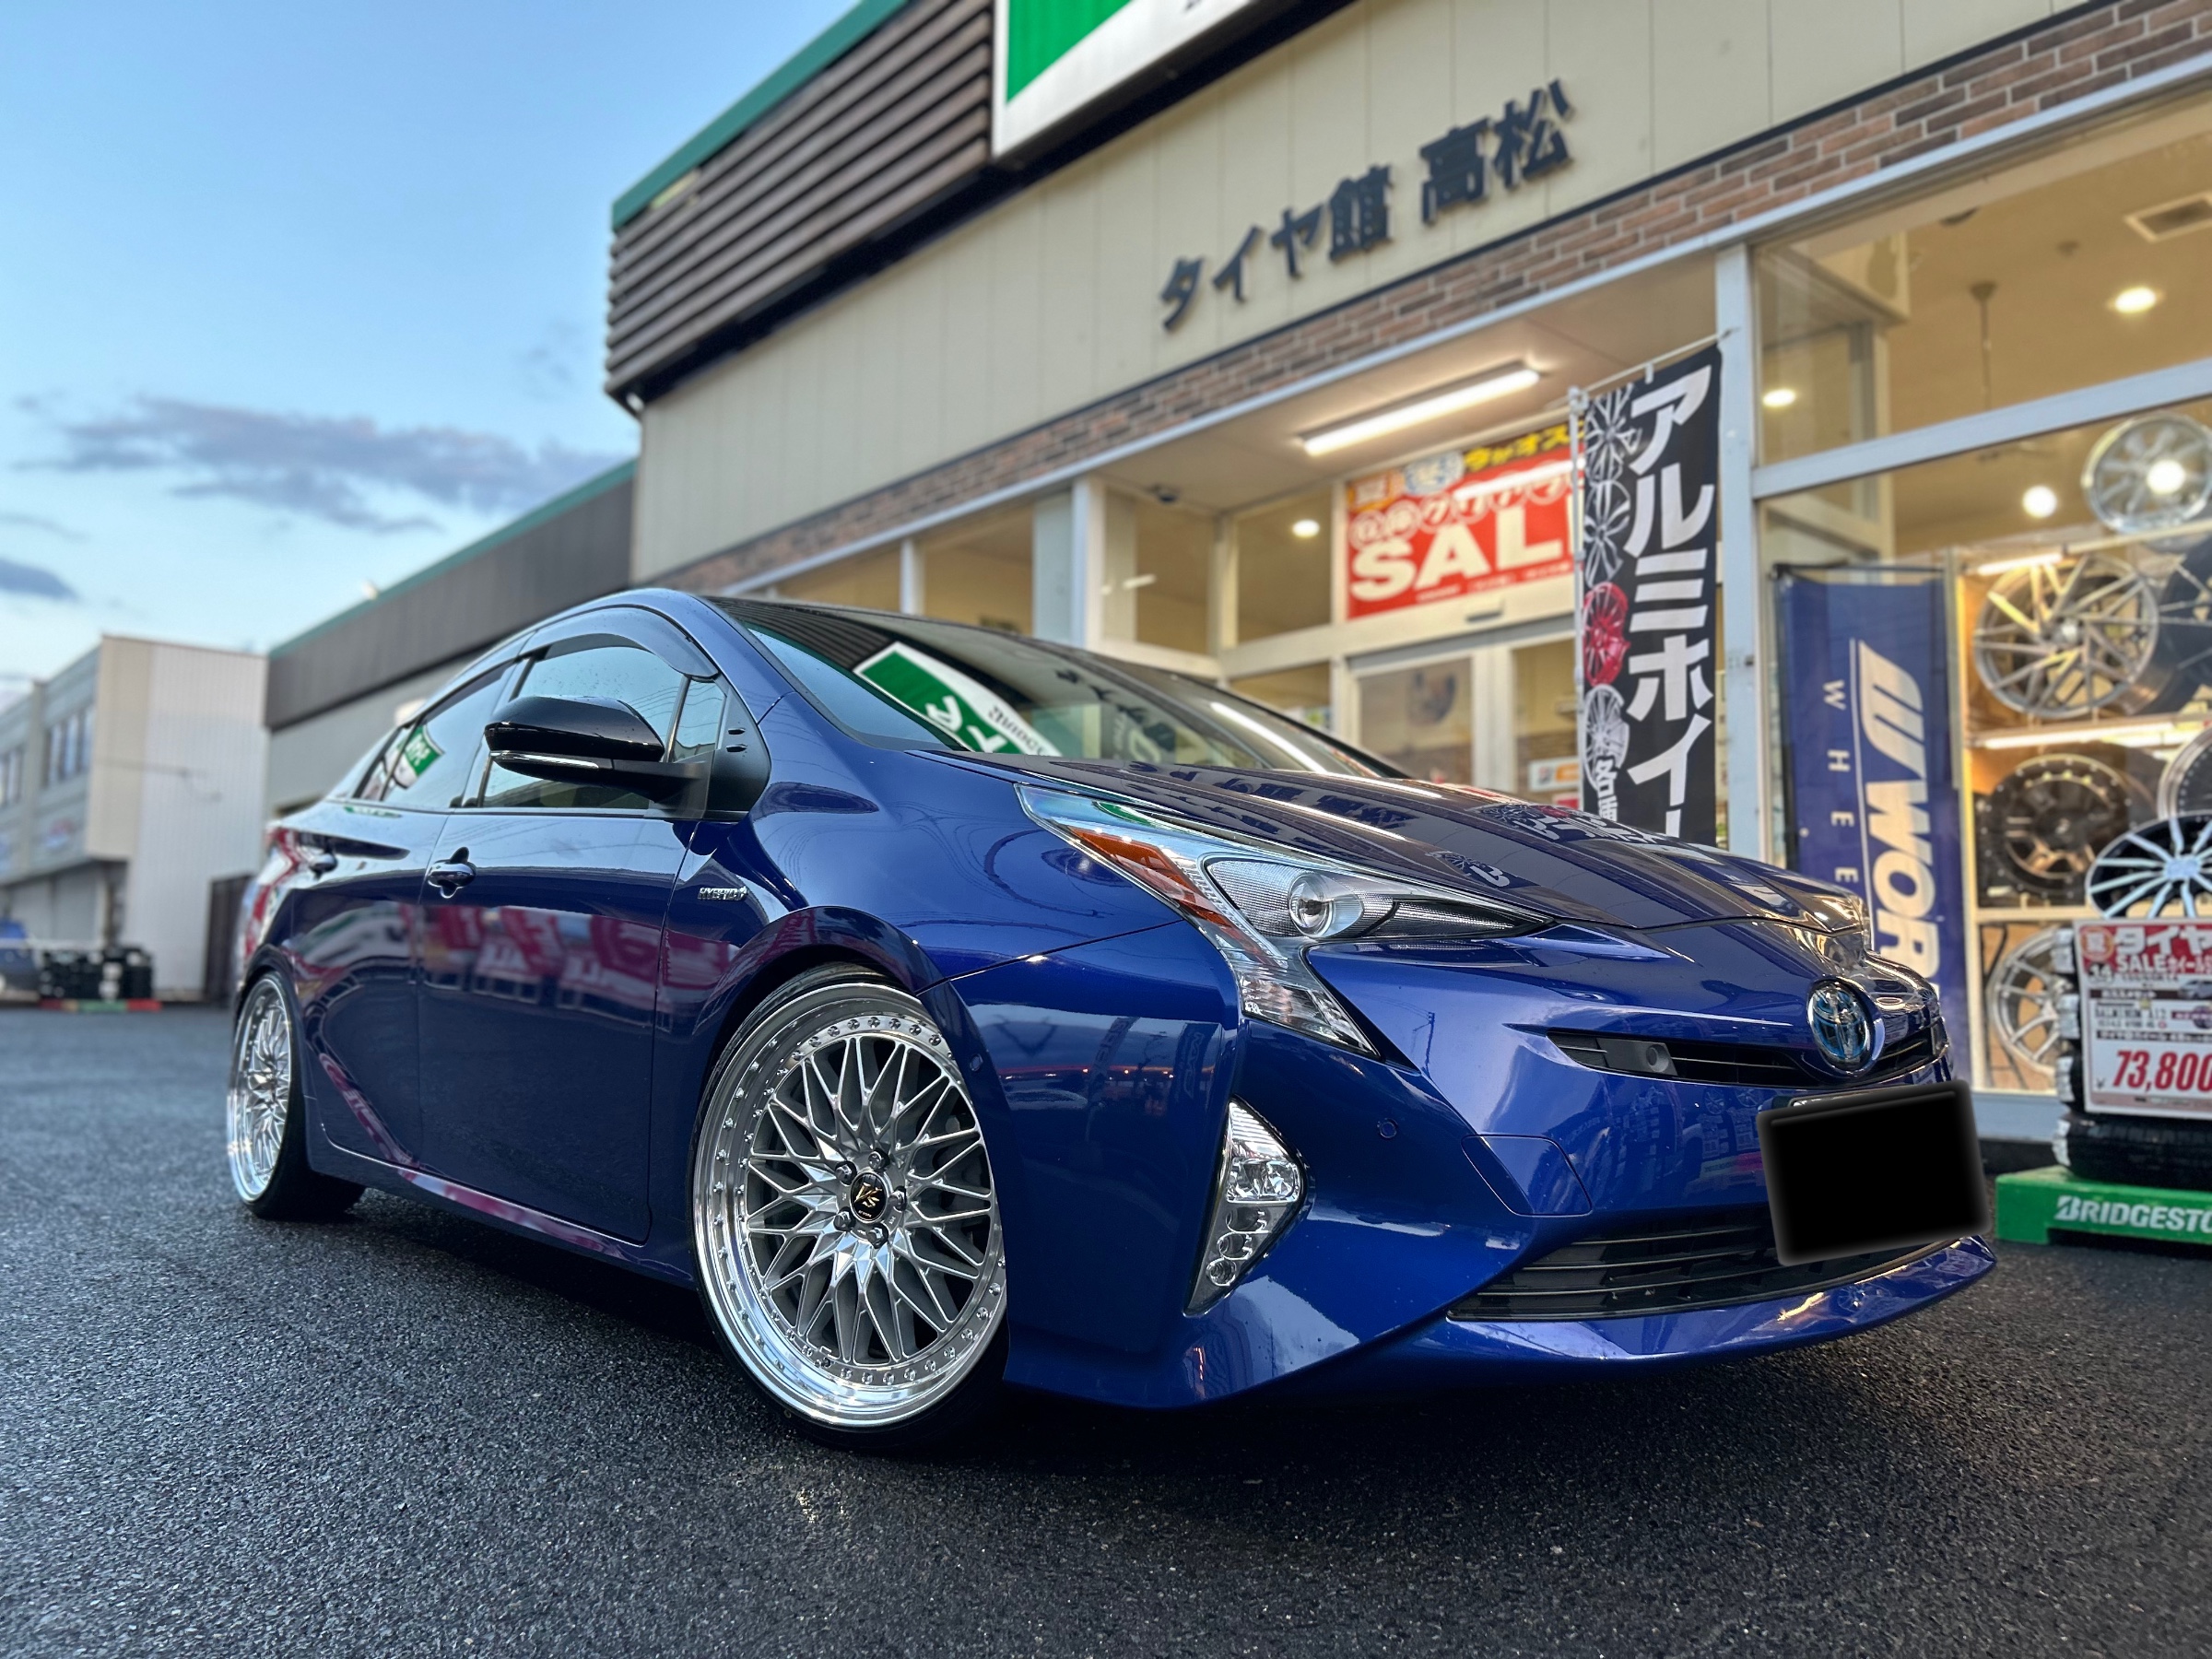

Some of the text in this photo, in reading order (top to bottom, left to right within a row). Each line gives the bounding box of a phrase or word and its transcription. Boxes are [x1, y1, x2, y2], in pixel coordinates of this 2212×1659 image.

[1160, 78, 1573, 331] タイヤ館 高松
[1865, 780, 1940, 1003] WOR
[2115, 925, 2212, 956] タイヤ
[2116, 953, 2167, 974] SALE
[2113, 1051, 2212, 1093] 73,800
